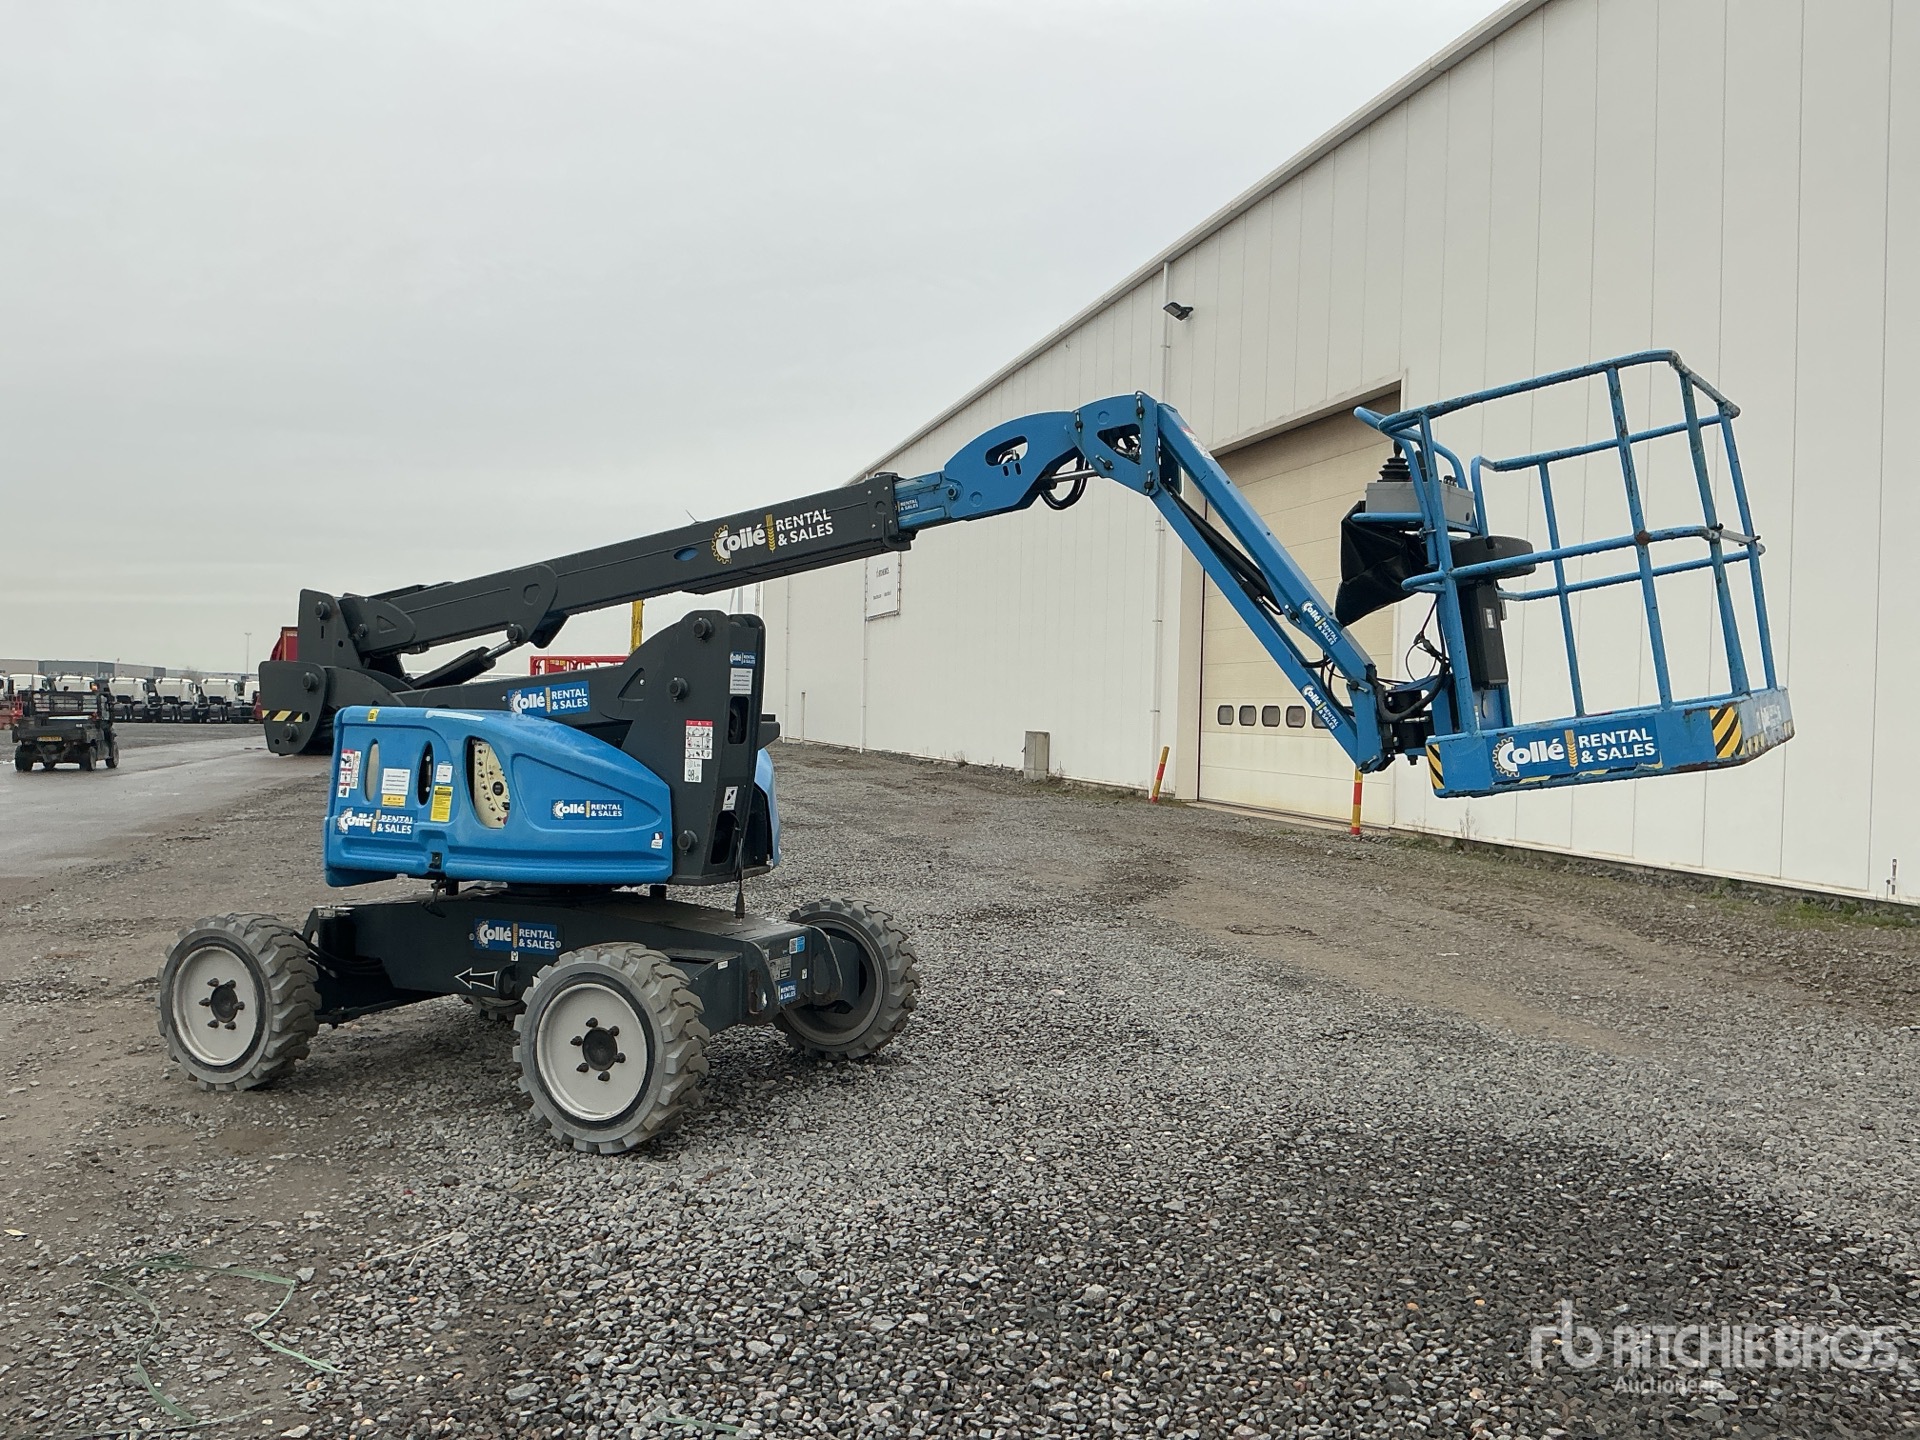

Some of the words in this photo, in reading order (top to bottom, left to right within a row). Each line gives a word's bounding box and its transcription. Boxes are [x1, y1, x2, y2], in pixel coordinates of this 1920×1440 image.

[900, 498, 918, 507] RENTAL
[775, 508, 832, 532] RENTAL
[714, 523, 766, 560] Collé
[778, 533, 788, 547] &
[789, 522, 834, 544] SALES
[1302, 602, 1321, 621] Collé
[1321, 620, 1338, 641] RENTAL
[1321, 628, 1335, 645] SALES
[512, 692, 546, 714] Collé
[551, 688, 587, 700] RENTAL
[1303, 686, 1322, 706] Collé
[551, 701, 559, 710] &
[560, 698, 588, 709] SALES
[1321, 711, 1336, 730] SALES
[1322, 704, 1339, 727] RENTAL
[1578, 728, 1653, 749] RENTAL
[1497, 738, 1565, 772] Collé
[1581, 751, 1594, 763] &
[1597, 742, 1656, 762] SALES
[555, 801, 585, 817] Collé
[377, 823, 384, 832] &
[385, 824, 412, 834] SALES
[378, 814, 413, 824] RENTAL
[479, 924, 512, 945] Collé
[518, 928, 555, 940] RENTAL
[518, 938, 526, 947] &
[526, 940, 555, 950] SALES
[780, 984, 796, 994] RENTAL
[783, 990, 797, 999] SALES
